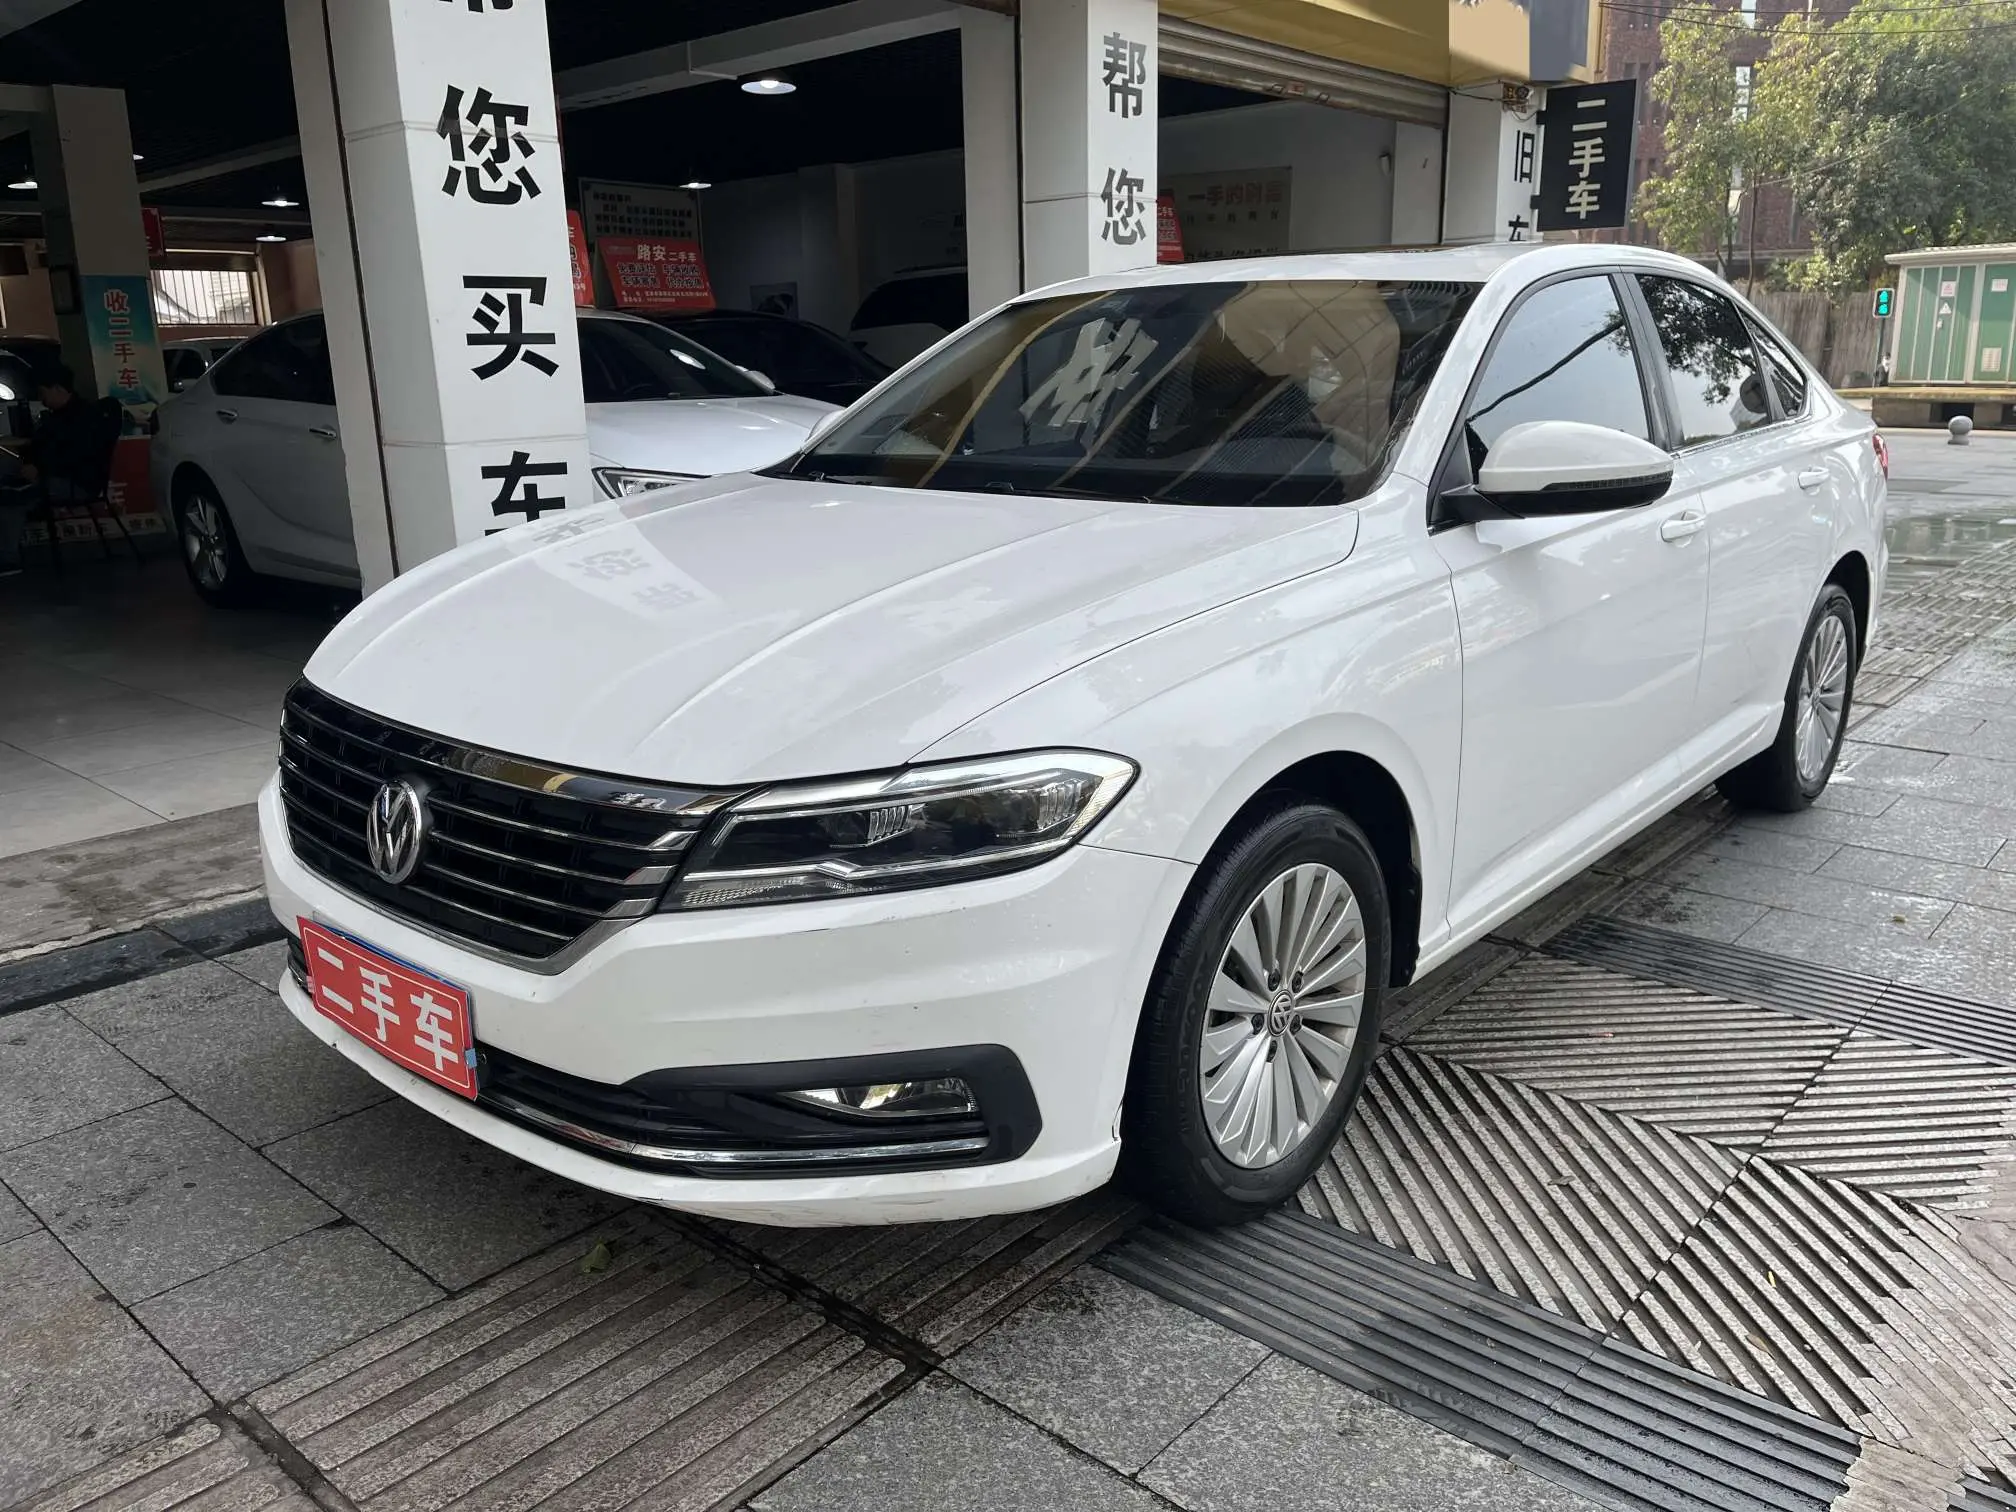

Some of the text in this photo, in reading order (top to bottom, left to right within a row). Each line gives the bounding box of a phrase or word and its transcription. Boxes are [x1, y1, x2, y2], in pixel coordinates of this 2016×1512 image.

[1100, 31, 1148, 246] 帮您
[1564, 98, 1608, 220] 二手车
[437, 0, 568, 536] 您买车
[103, 288, 141, 390] 收二手车
[317, 946, 459, 1071] 二手车
